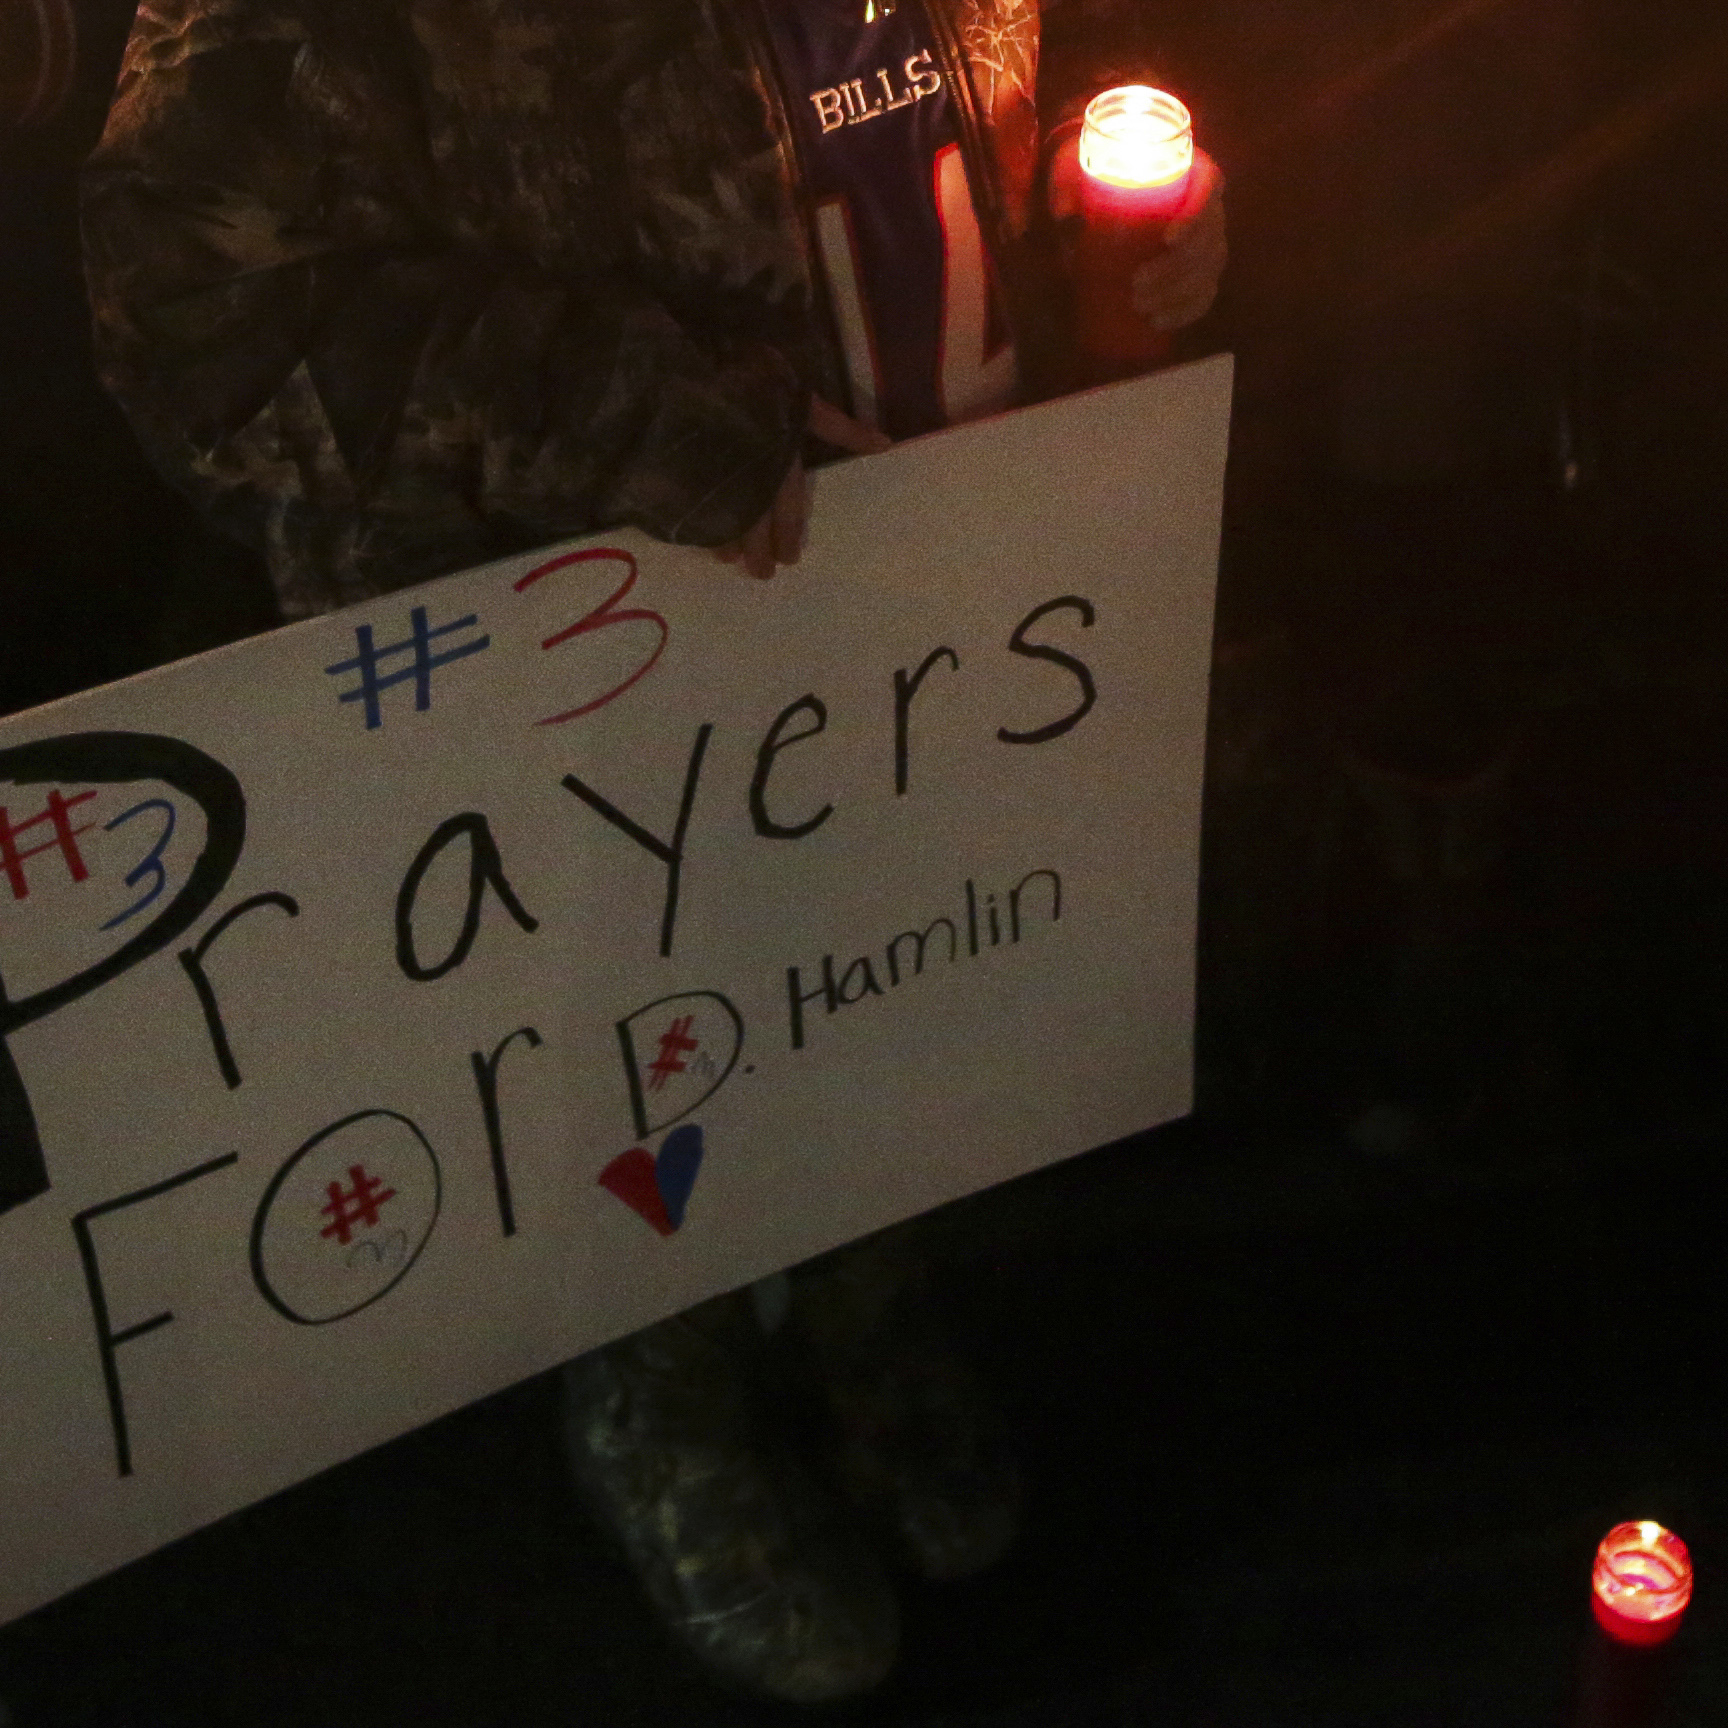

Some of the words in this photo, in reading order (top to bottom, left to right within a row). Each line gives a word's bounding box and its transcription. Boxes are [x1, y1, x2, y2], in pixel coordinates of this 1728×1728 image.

[809, 47, 942, 134] BILLS
[324, 546, 669, 730] #3
[786, 867, 1064, 1051] Hamlin
